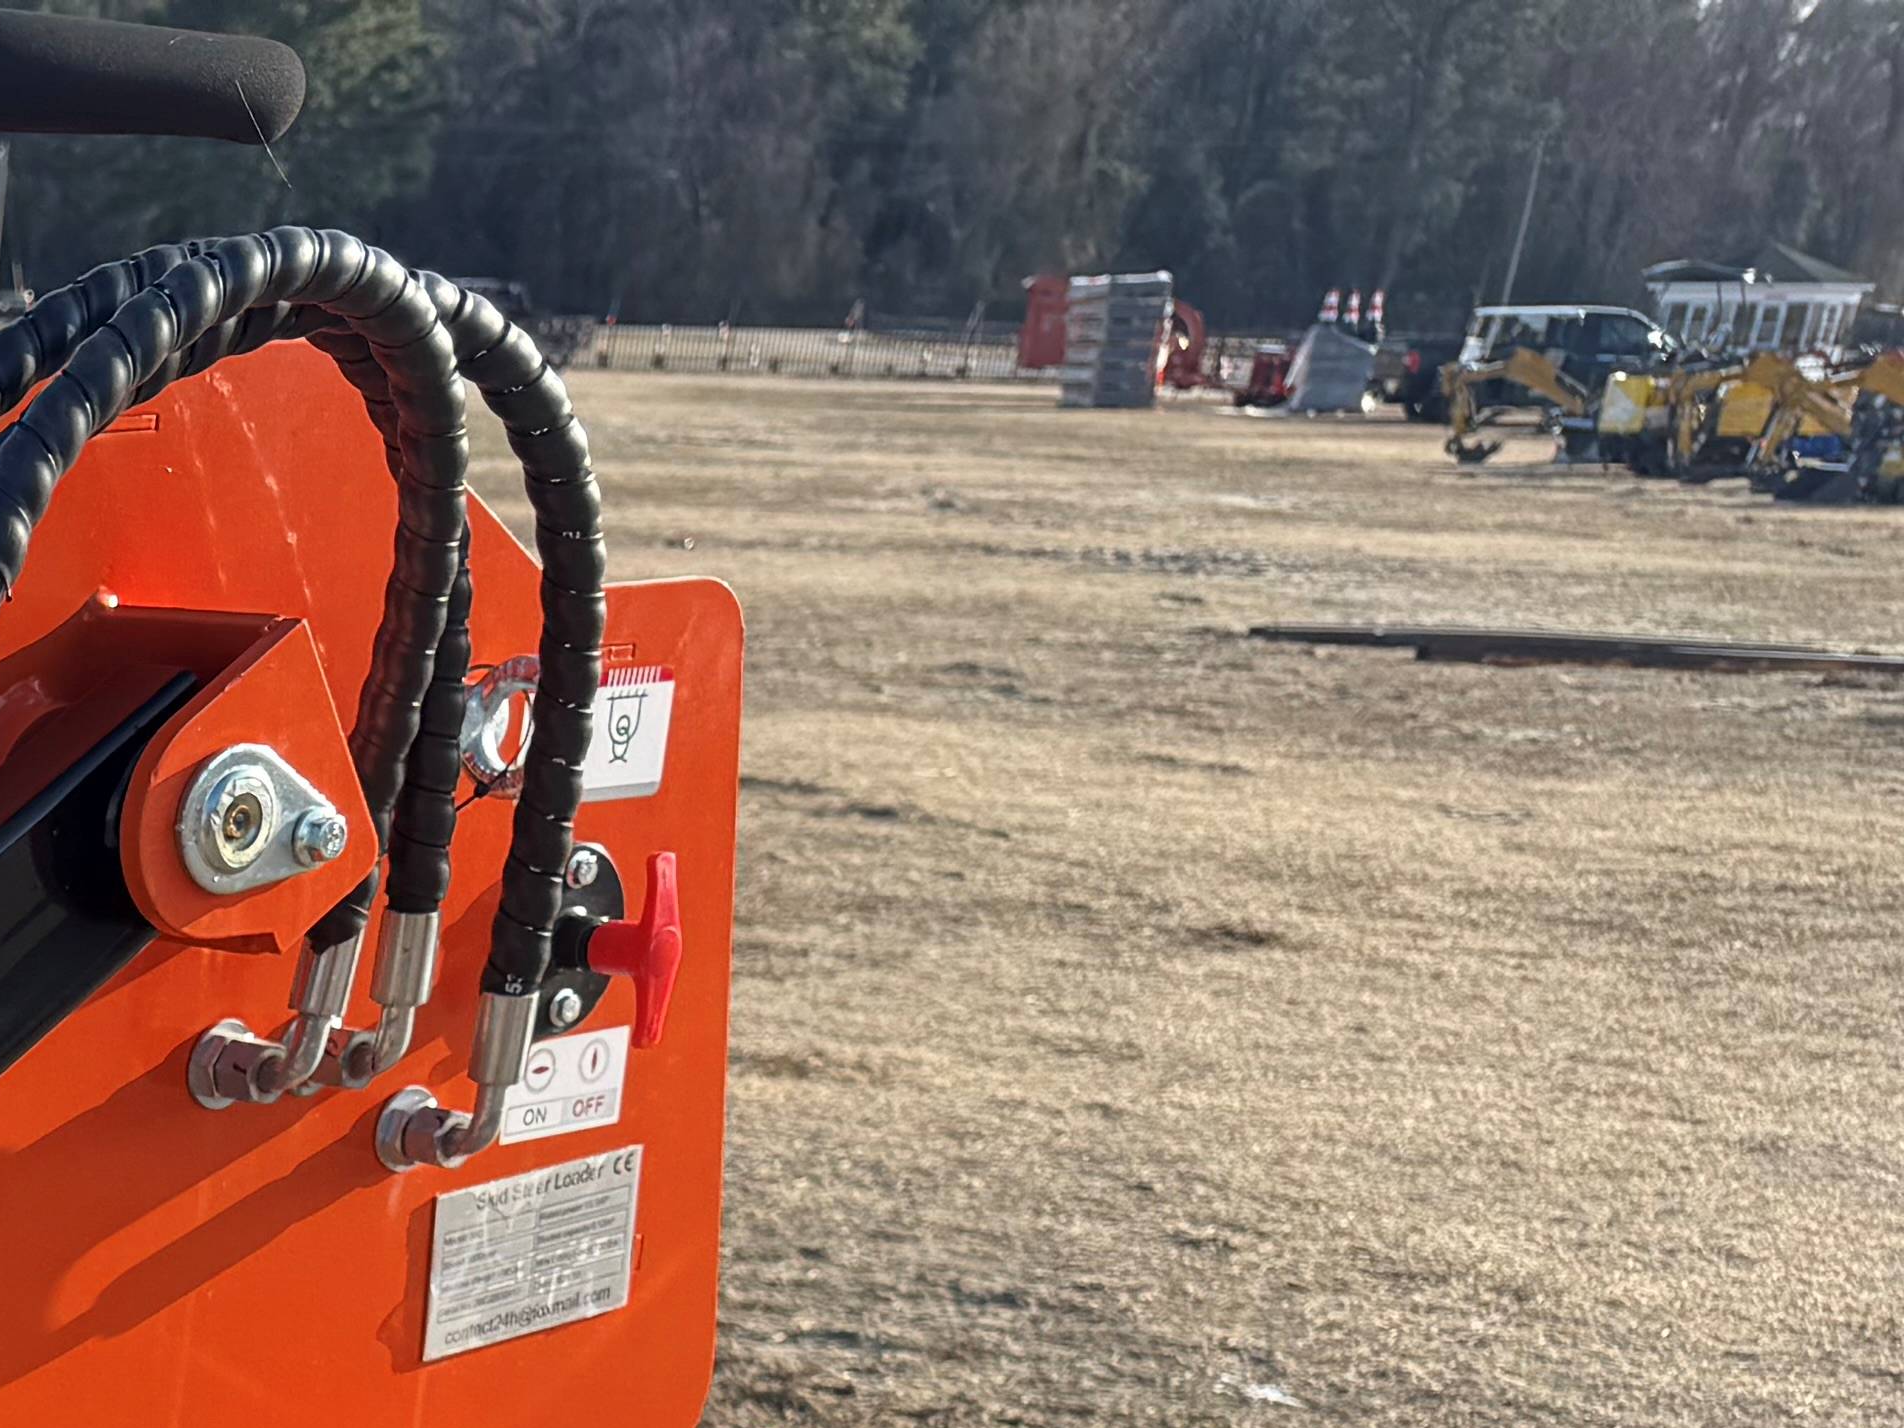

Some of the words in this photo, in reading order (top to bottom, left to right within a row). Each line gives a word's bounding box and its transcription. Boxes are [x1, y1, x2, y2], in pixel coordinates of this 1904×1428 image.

[523, 1108, 547, 1126] ON
[572, 1096, 605, 1117] OFF
[554, 1161, 604, 1190] Loader
